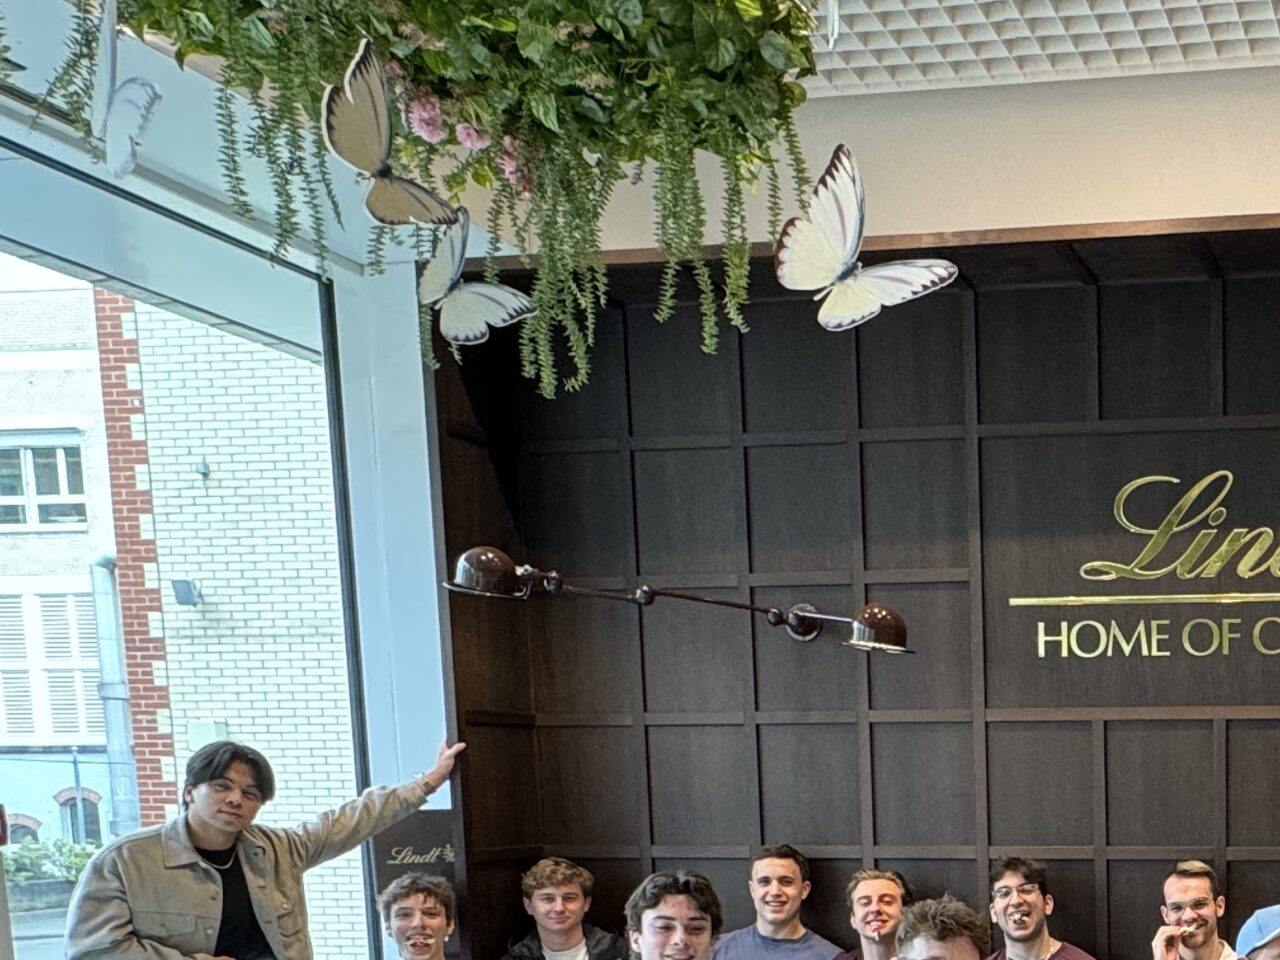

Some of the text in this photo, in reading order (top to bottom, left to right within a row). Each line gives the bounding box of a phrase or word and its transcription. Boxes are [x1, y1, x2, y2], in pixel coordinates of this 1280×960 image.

[1037, 620, 1171, 658] HOME
[1181, 618, 1242, 656] OF
[386, 846, 442, 864] Lindt
